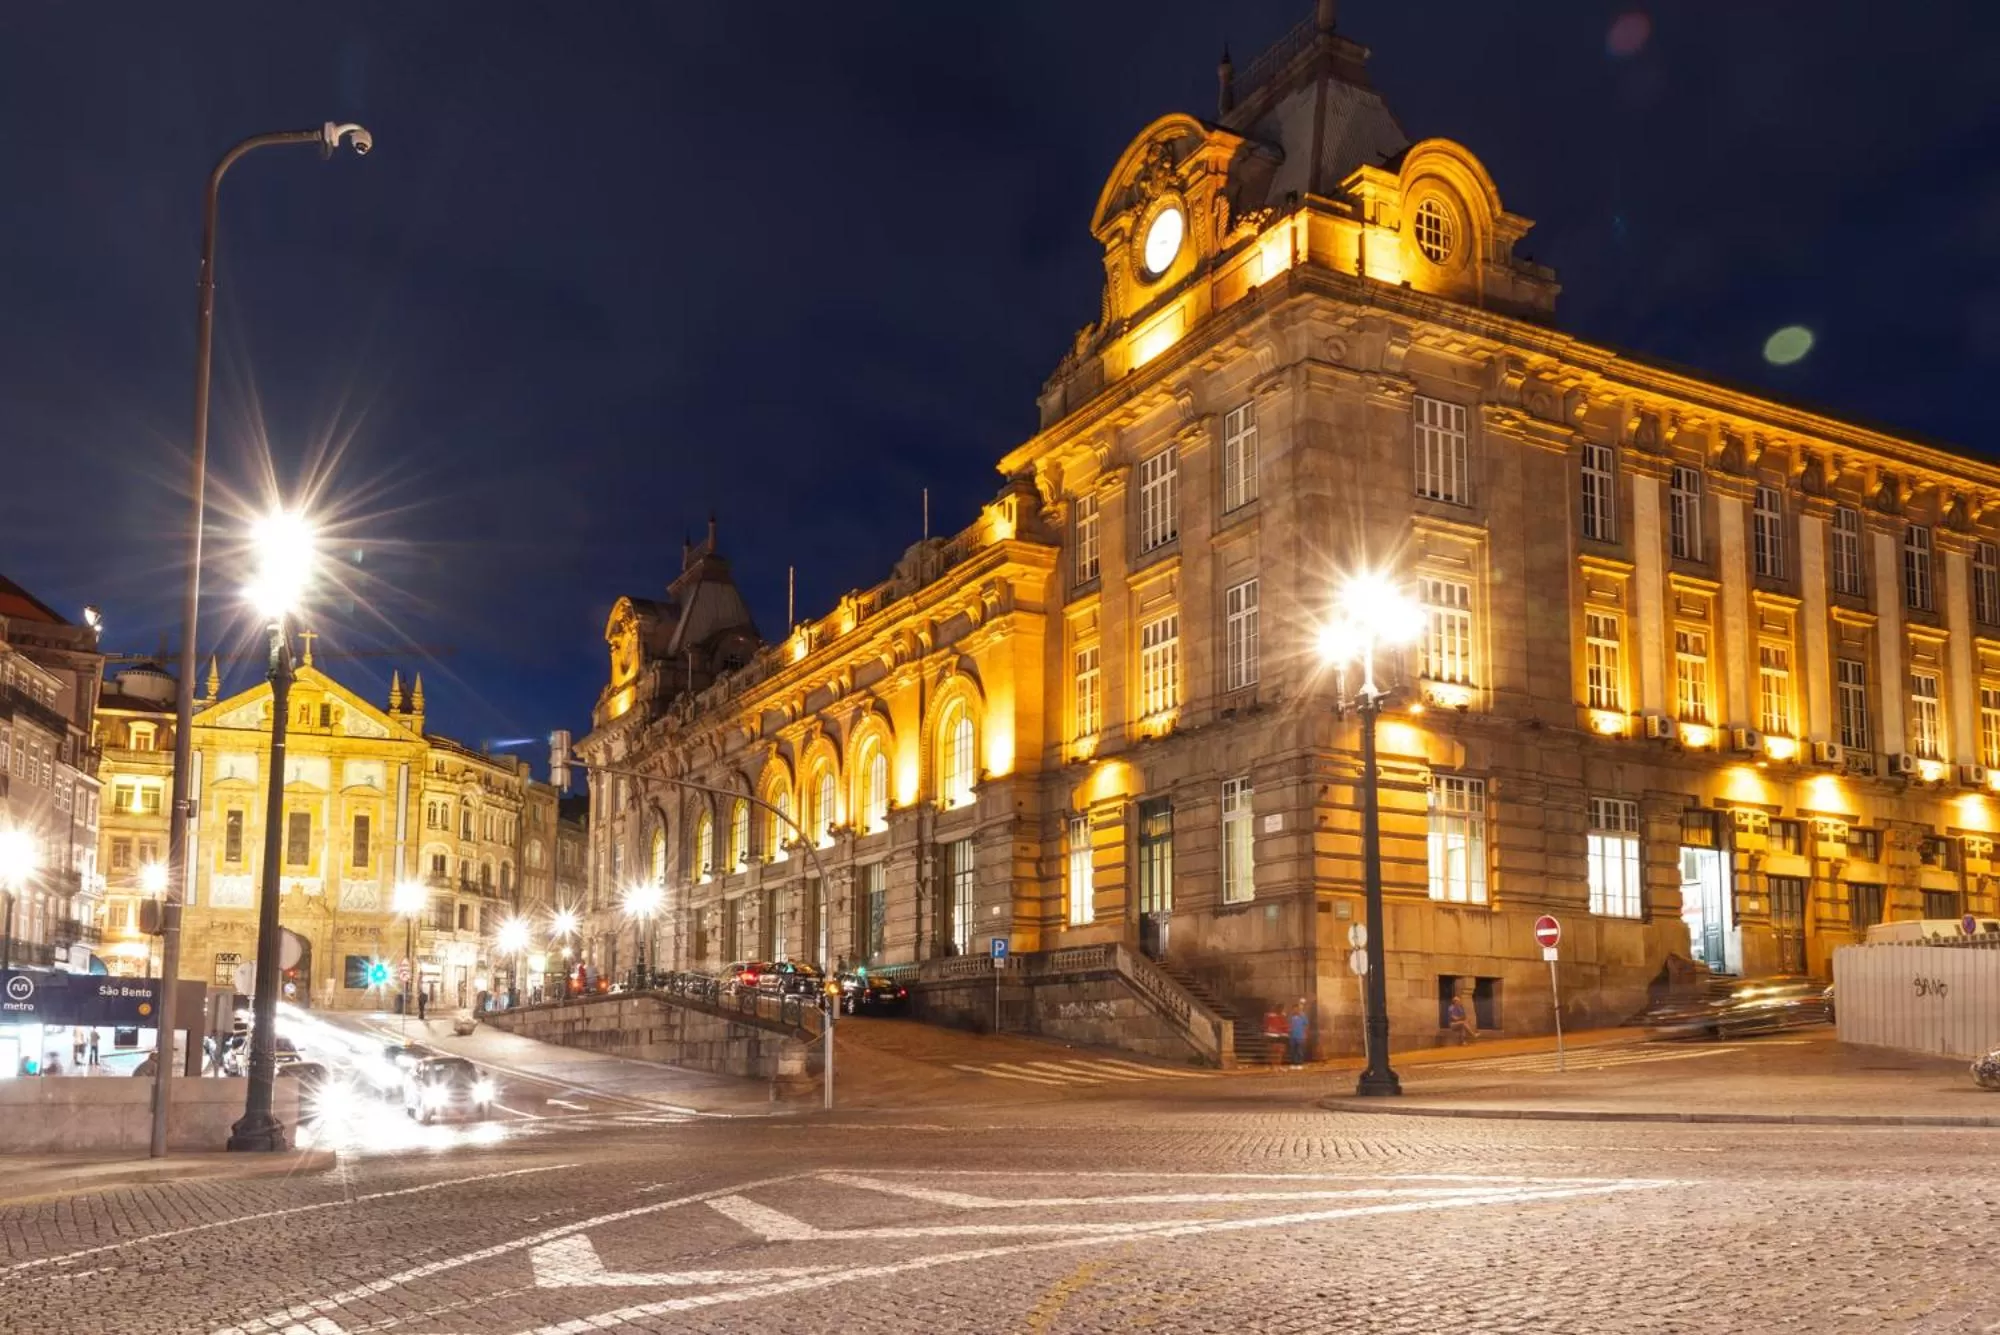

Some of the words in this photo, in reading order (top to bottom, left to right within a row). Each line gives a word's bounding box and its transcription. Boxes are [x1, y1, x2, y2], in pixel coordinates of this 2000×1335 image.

[995, 940, 1005, 957] P
[121, 986, 153, 998] Bento
[3, 1002, 35, 1011] metro
